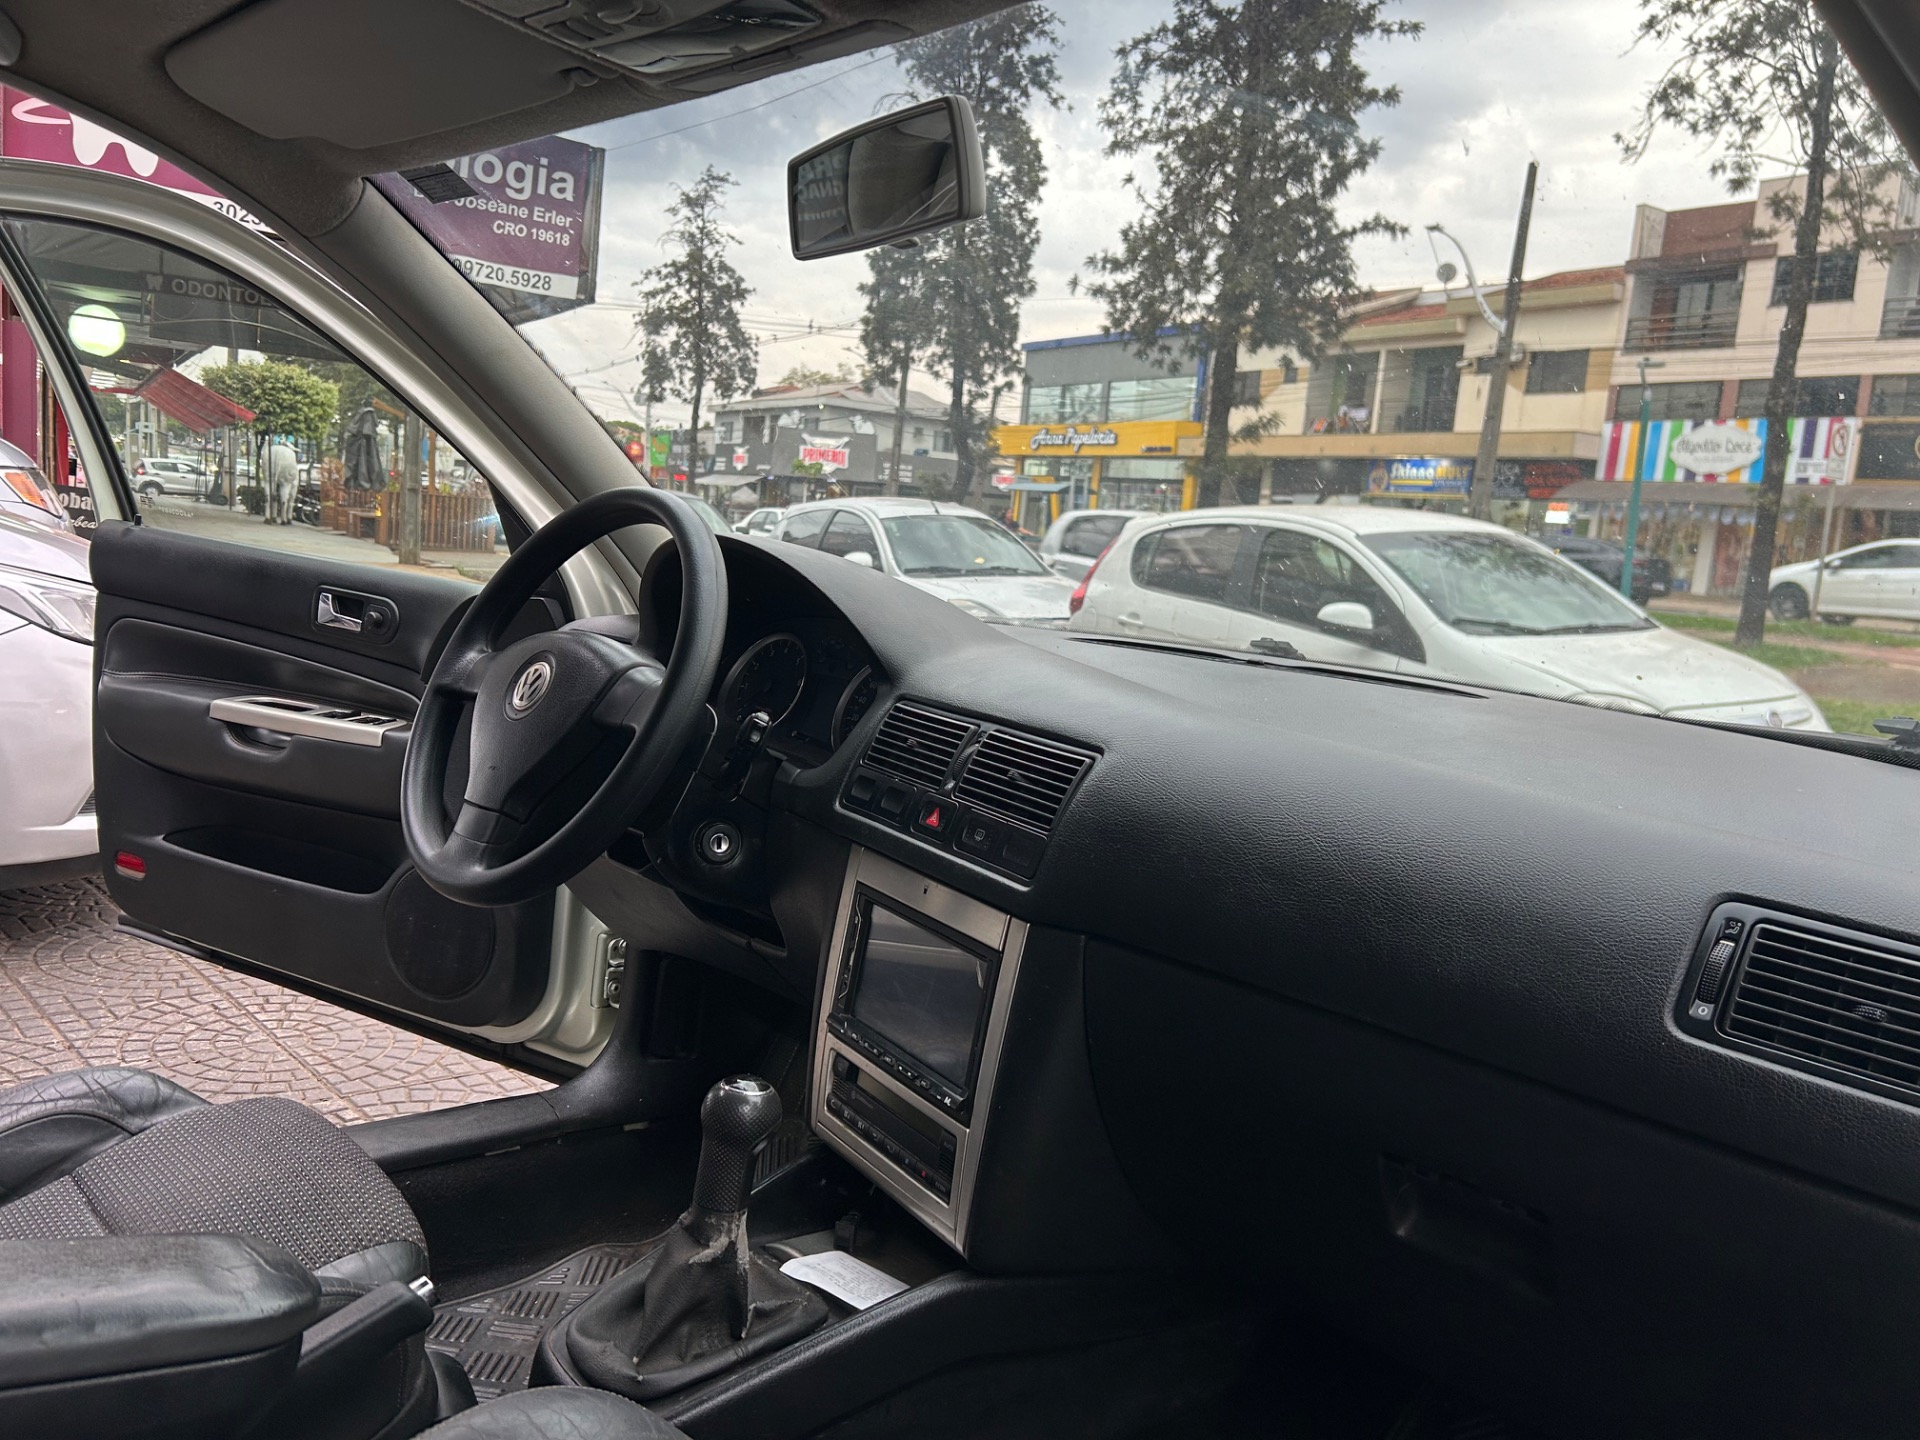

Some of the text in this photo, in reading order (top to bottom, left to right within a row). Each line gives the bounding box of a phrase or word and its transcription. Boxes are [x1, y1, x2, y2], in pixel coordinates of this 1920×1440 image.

[532, 204, 573, 228] Erler
[492, 220, 571, 247] CRO 19618
